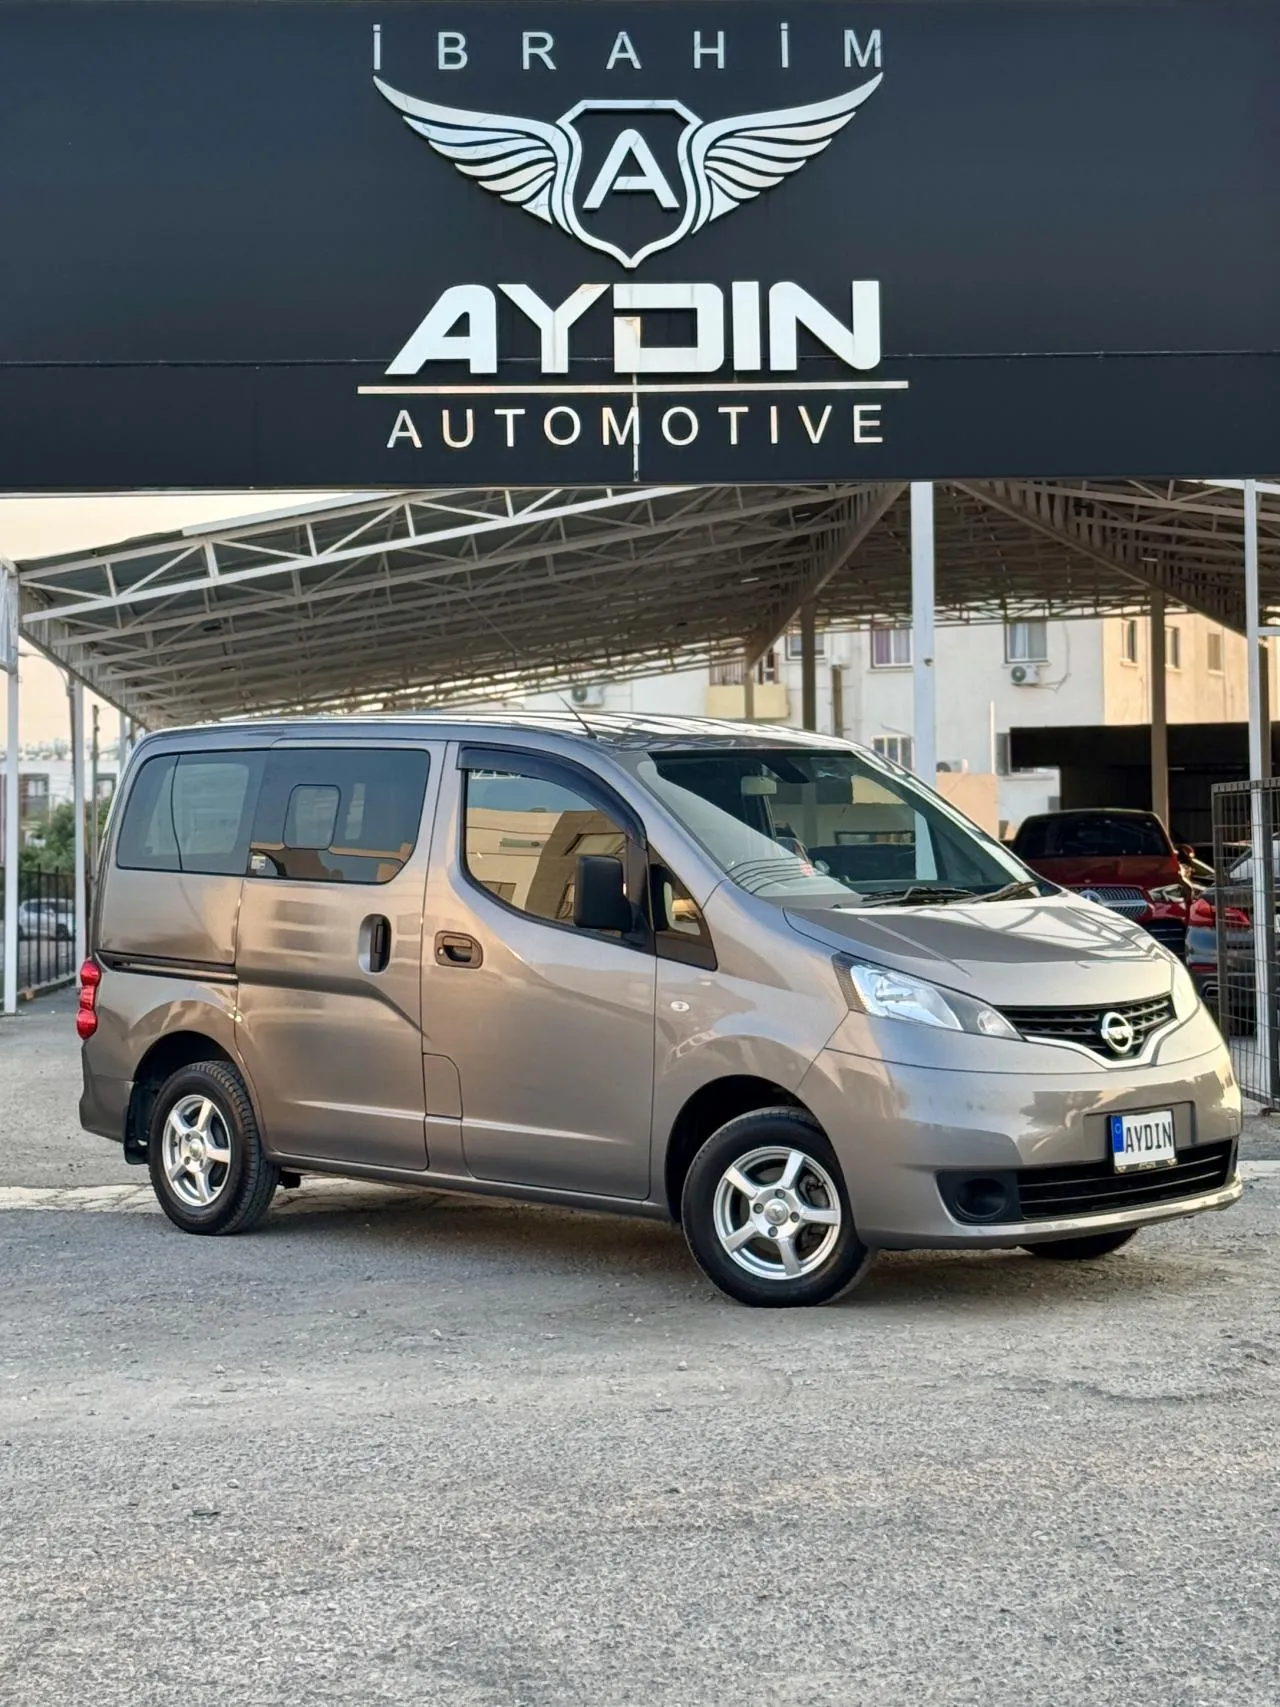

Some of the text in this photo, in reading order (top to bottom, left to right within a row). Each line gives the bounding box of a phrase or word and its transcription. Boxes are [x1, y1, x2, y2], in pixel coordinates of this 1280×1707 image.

[582, 128, 681, 210] A
[384, 280, 881, 375] AYDIN
[386, 404, 884, 449] AUTOMOTIVE
[1125, 1121, 1172, 1153] AYDIN
